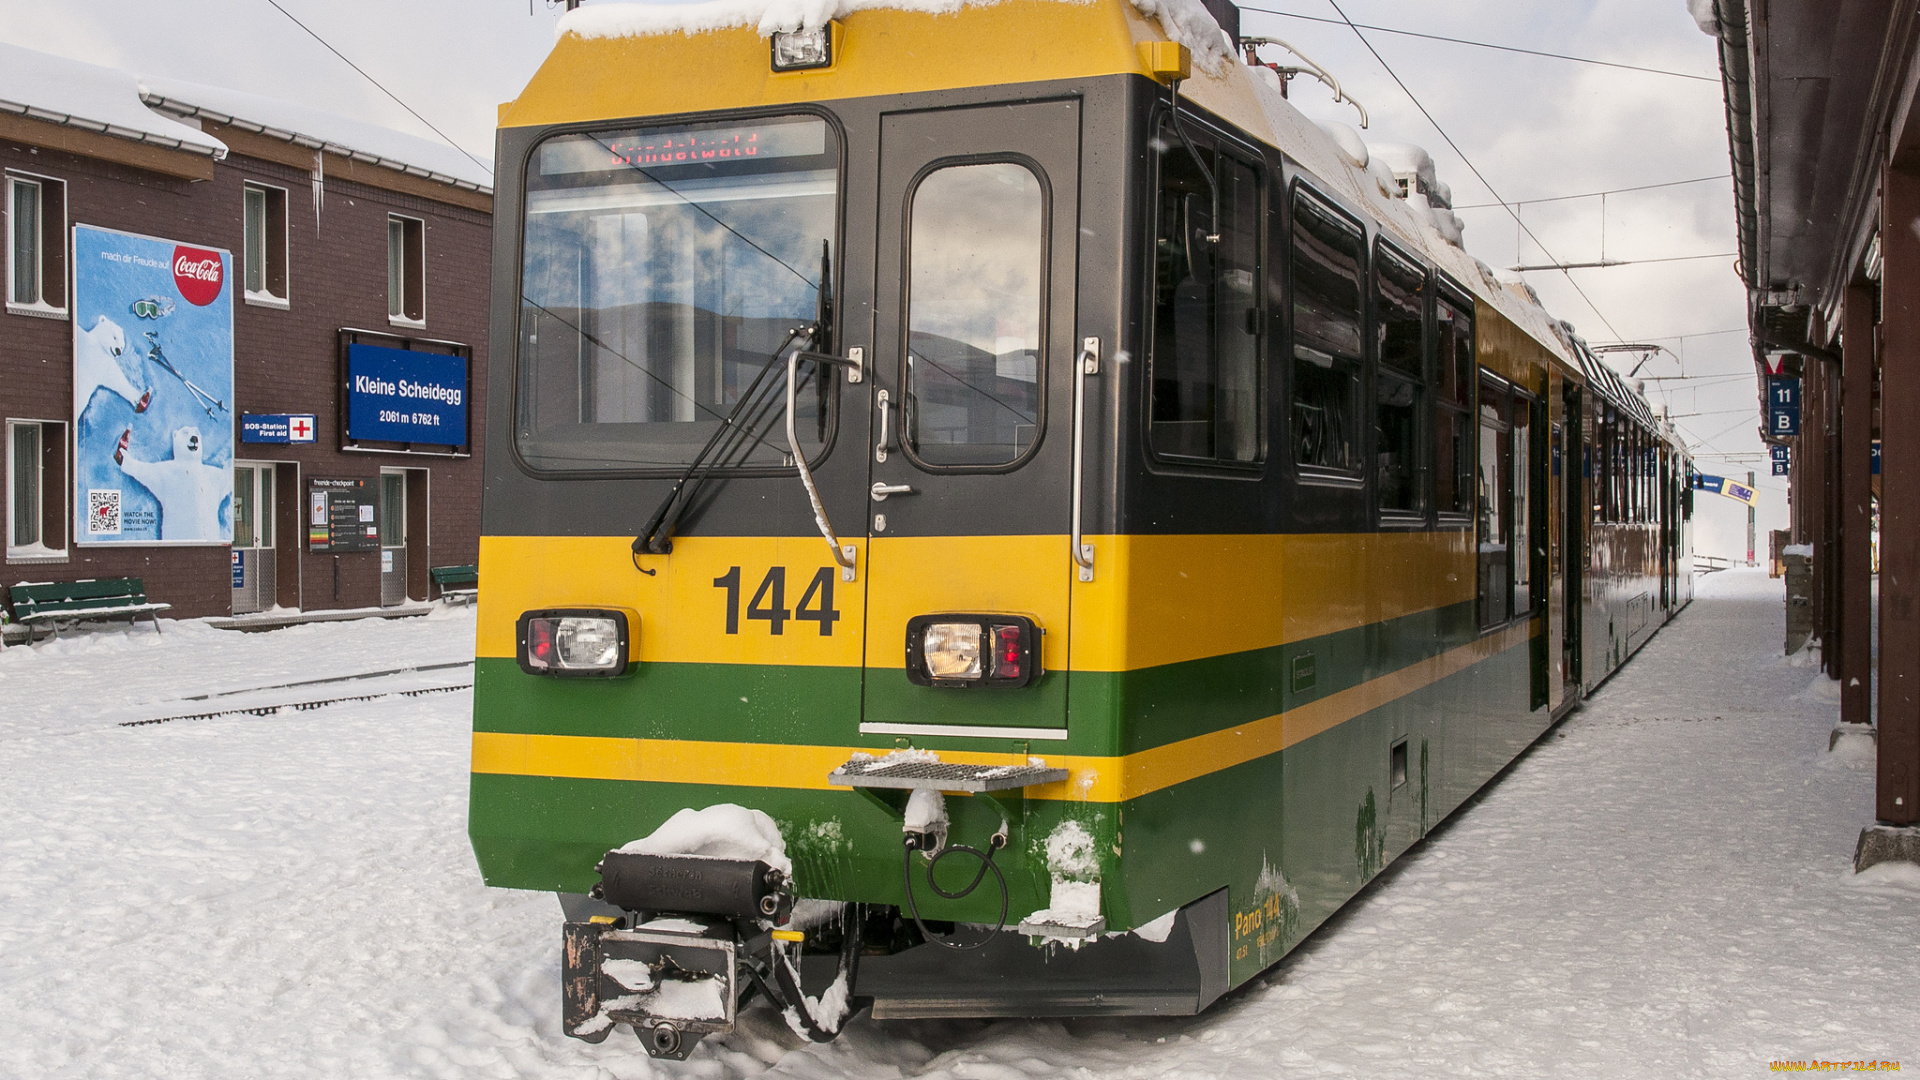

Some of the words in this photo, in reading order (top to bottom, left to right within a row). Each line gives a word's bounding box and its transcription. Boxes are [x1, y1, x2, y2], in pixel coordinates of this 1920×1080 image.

[101, 251, 121, 262] mach
[122, 255, 131, 263] dir
[133, 255, 157, 268] Freude
[158, 260, 169, 270] auf
[175, 255, 221, 282] Coca-Cola
[355, 375, 396, 396] Kleine
[398, 379, 461, 406] Scheidegg
[1777, 389, 1790, 403] 11
[1778, 415, 1790, 429] B
[1776, 451, 1784, 459] 11
[1776, 464, 1784, 473] B
[713, 566, 840, 636] 144
[1235, 908, 1262, 941] Pano
